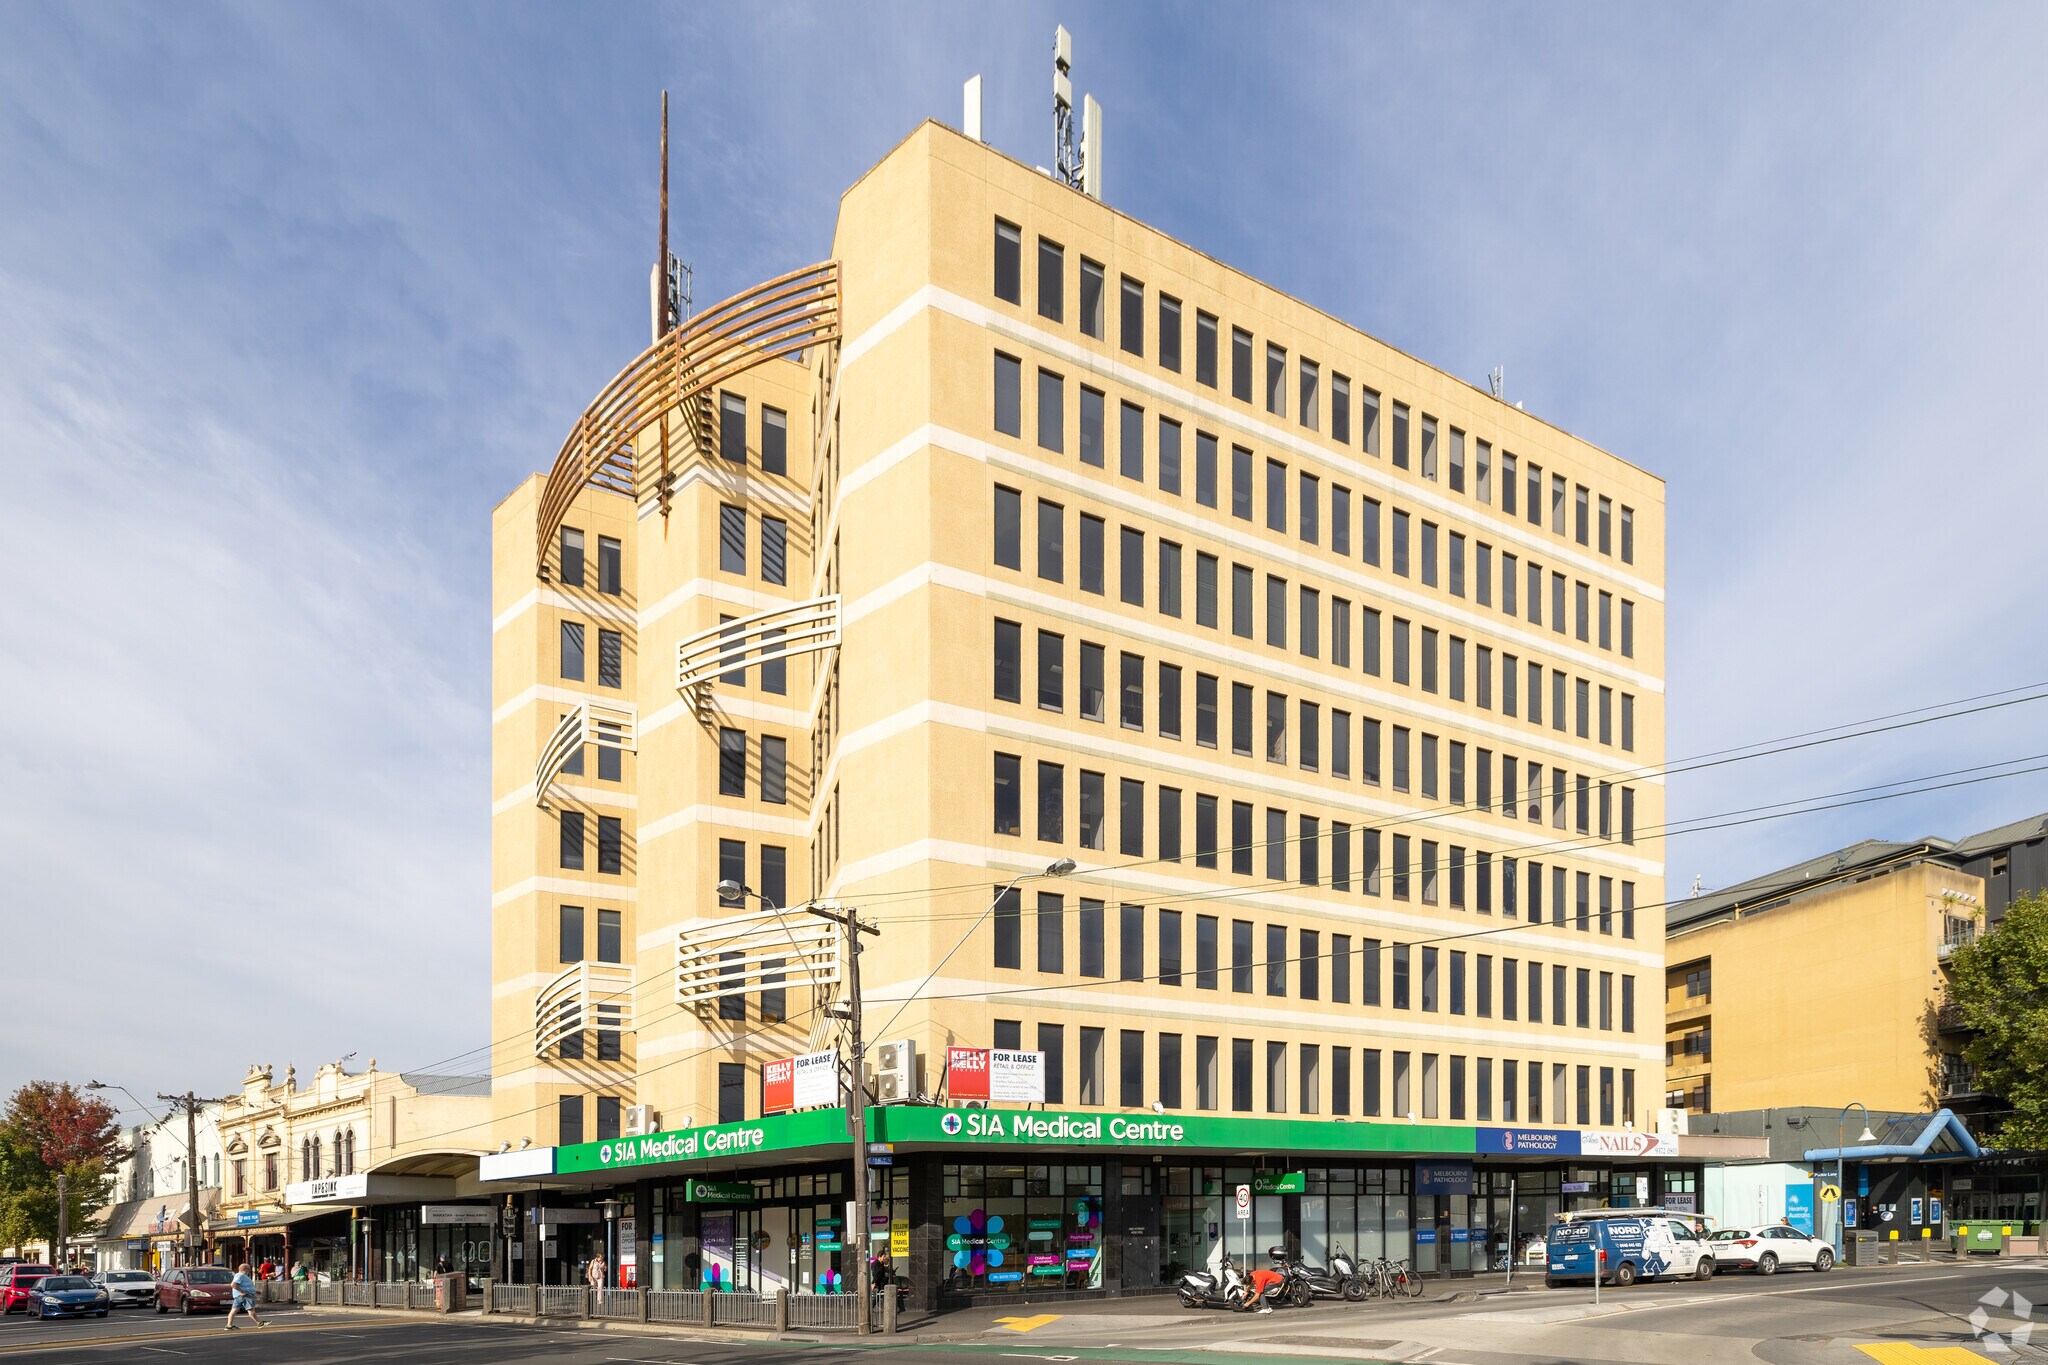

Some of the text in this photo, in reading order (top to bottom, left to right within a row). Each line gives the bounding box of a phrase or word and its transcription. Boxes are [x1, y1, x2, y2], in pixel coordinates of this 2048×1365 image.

[951, 1050, 986, 1061] KELLY
[994, 1053, 1036, 1063] FOR LEASE
[796, 1054, 830, 1068] FOR LEASE
[951, 1060, 986, 1070] KELLY
[766, 1062, 792, 1074] KELLY
[766, 1070, 792, 1083] KELLY
[967, 1114, 1184, 1140] SIA Medical Centre
[1518, 1134, 1557, 1142] MELBOURNE
[615, 1128, 764, 1162] SIA Medical Centre
[1518, 1142, 1557, 1150] PATHOLOGY
[1600, 1136, 1642, 1151] NAILS
[1434, 1176, 1468, 1184] PATHOLOGY
[1239, 1194, 1247, 1202] 40
[622, 1222, 633, 1230] FOR
[1557, 1228, 1588, 1236] NORD
